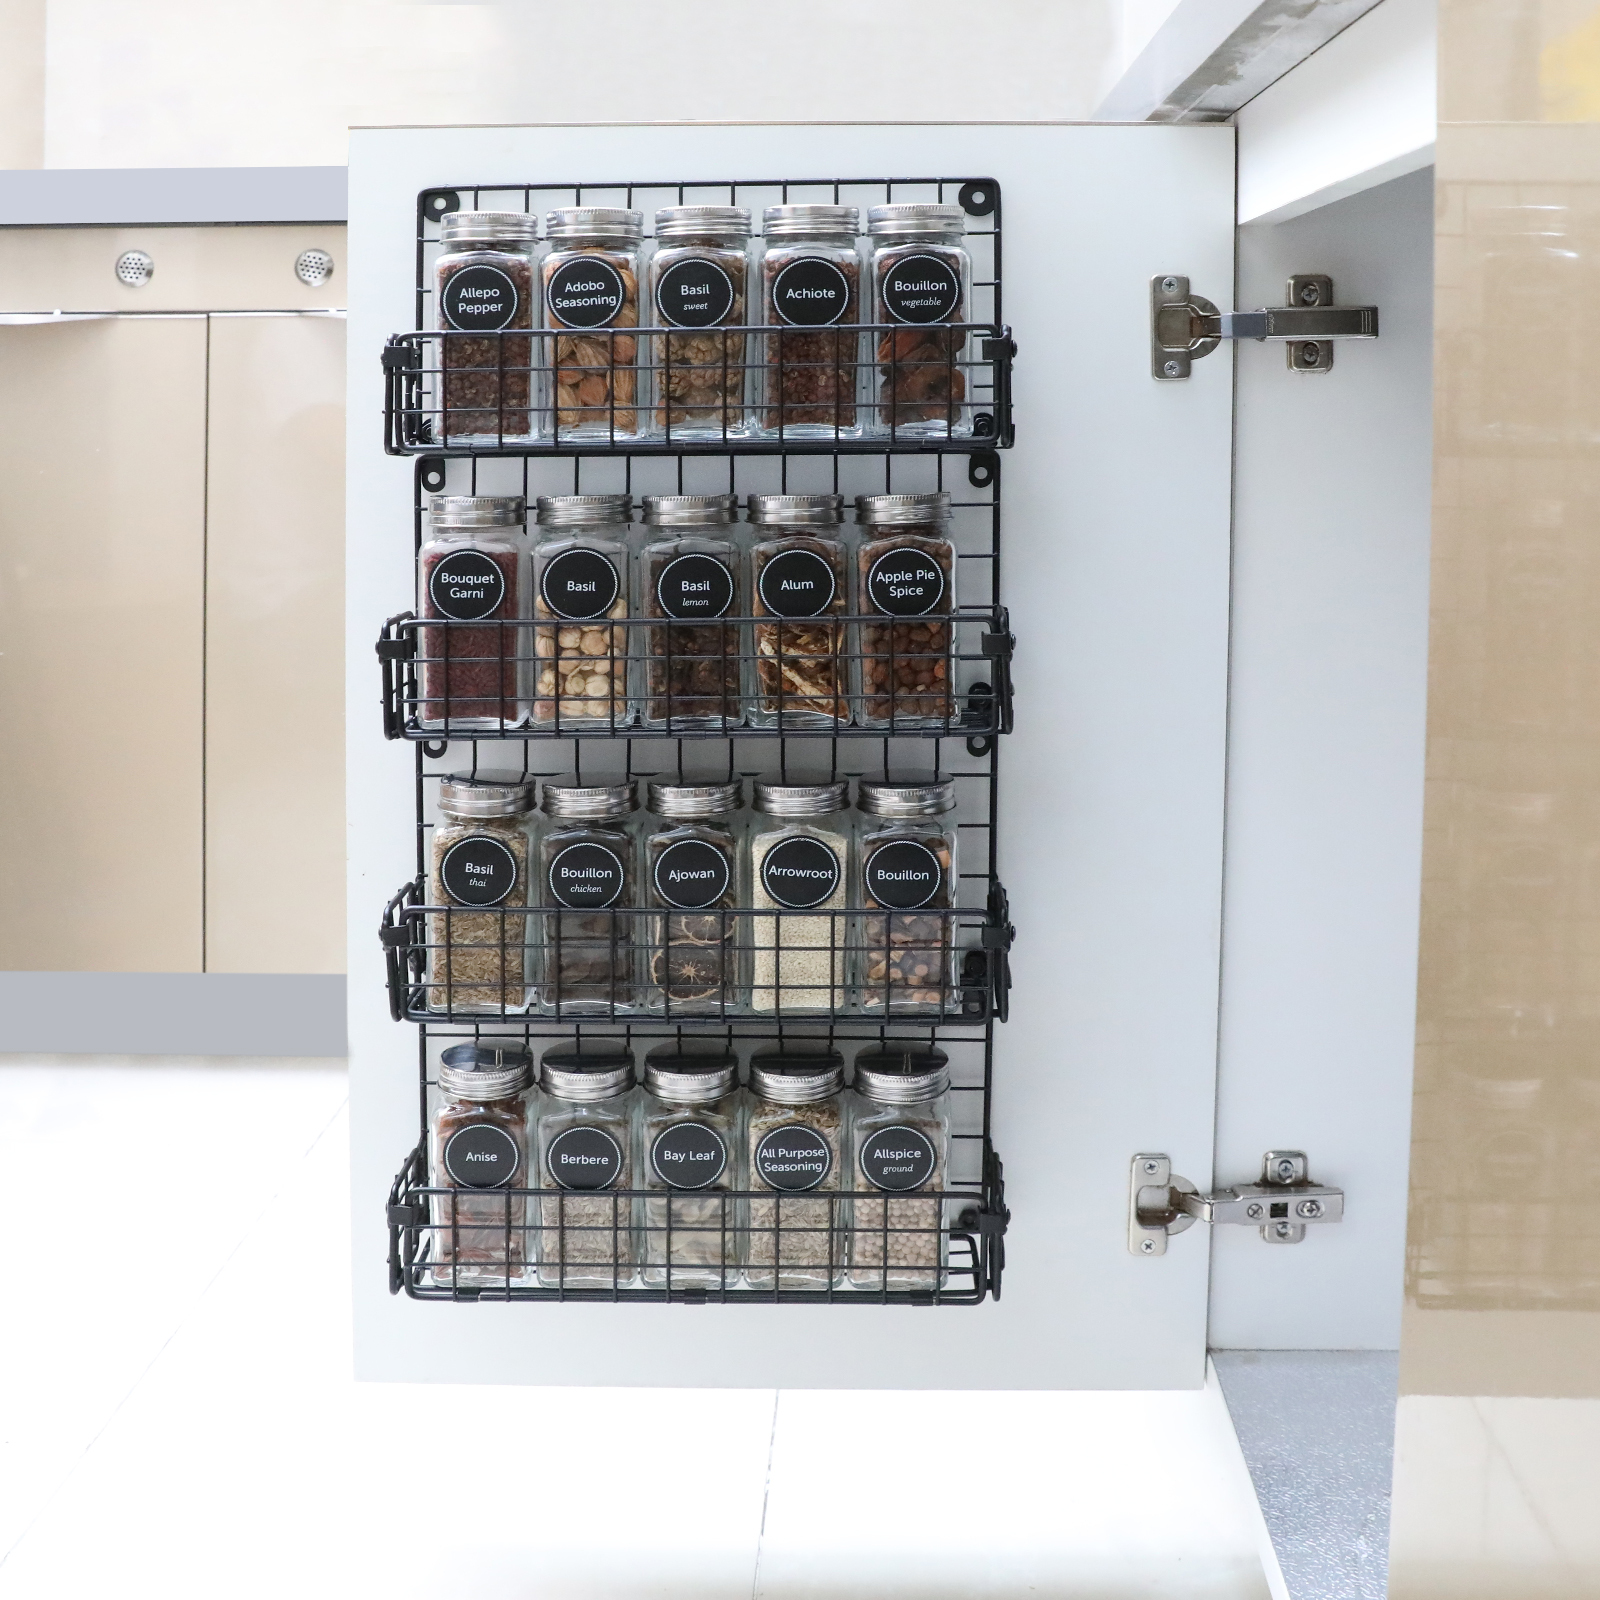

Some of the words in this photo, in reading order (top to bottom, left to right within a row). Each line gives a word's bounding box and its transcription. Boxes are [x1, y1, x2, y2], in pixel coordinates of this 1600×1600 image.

[564, 280, 605, 293] Adobo
[680, 283, 710, 296] Basil
[894, 280, 947, 292] Bouillon
[459, 287, 500, 300] Allepo
[785, 287, 836, 299] Achiote
[555, 294, 617, 310] Seasoning
[683, 302, 708, 311] sweet
[900, 296, 942, 309] vegetable
[458, 302, 504, 316] Pepper
[441, 572, 495, 586] Bouquet
[875, 570, 914, 585] Apple
[916, 569, 936, 581] Pie
[566, 580, 596, 592] Basil
[681, 580, 711, 592] Basil
[780, 579, 814, 591] Alum
[449, 587, 484, 599] Garni
[889, 585, 924, 599] Spice
[682, 597, 709, 607] lemon
[465, 862, 494, 875] Basil
[561, 867, 613, 879] Bouillon
[767, 864, 833, 879] Arrowroot
[668, 869, 715, 883] Ajowan
[877, 869, 929, 881] Bouillon
[469, 877, 487, 887] thai
[570, 883, 603, 893] chicken
[465, 1151, 498, 1162] Anise
[560, 1153, 609, 1165] Berbere
[663, 1150, 684, 1163] Bay
[687, 1150, 716, 1161] Leaf
[760, 1148, 775, 1159] All
[777, 1148, 825, 1160] Purpose
[873, 1148, 922, 1161] Allspice
[764, 1161, 823, 1173] Seasoning
[882, 1163, 914, 1175] ground
